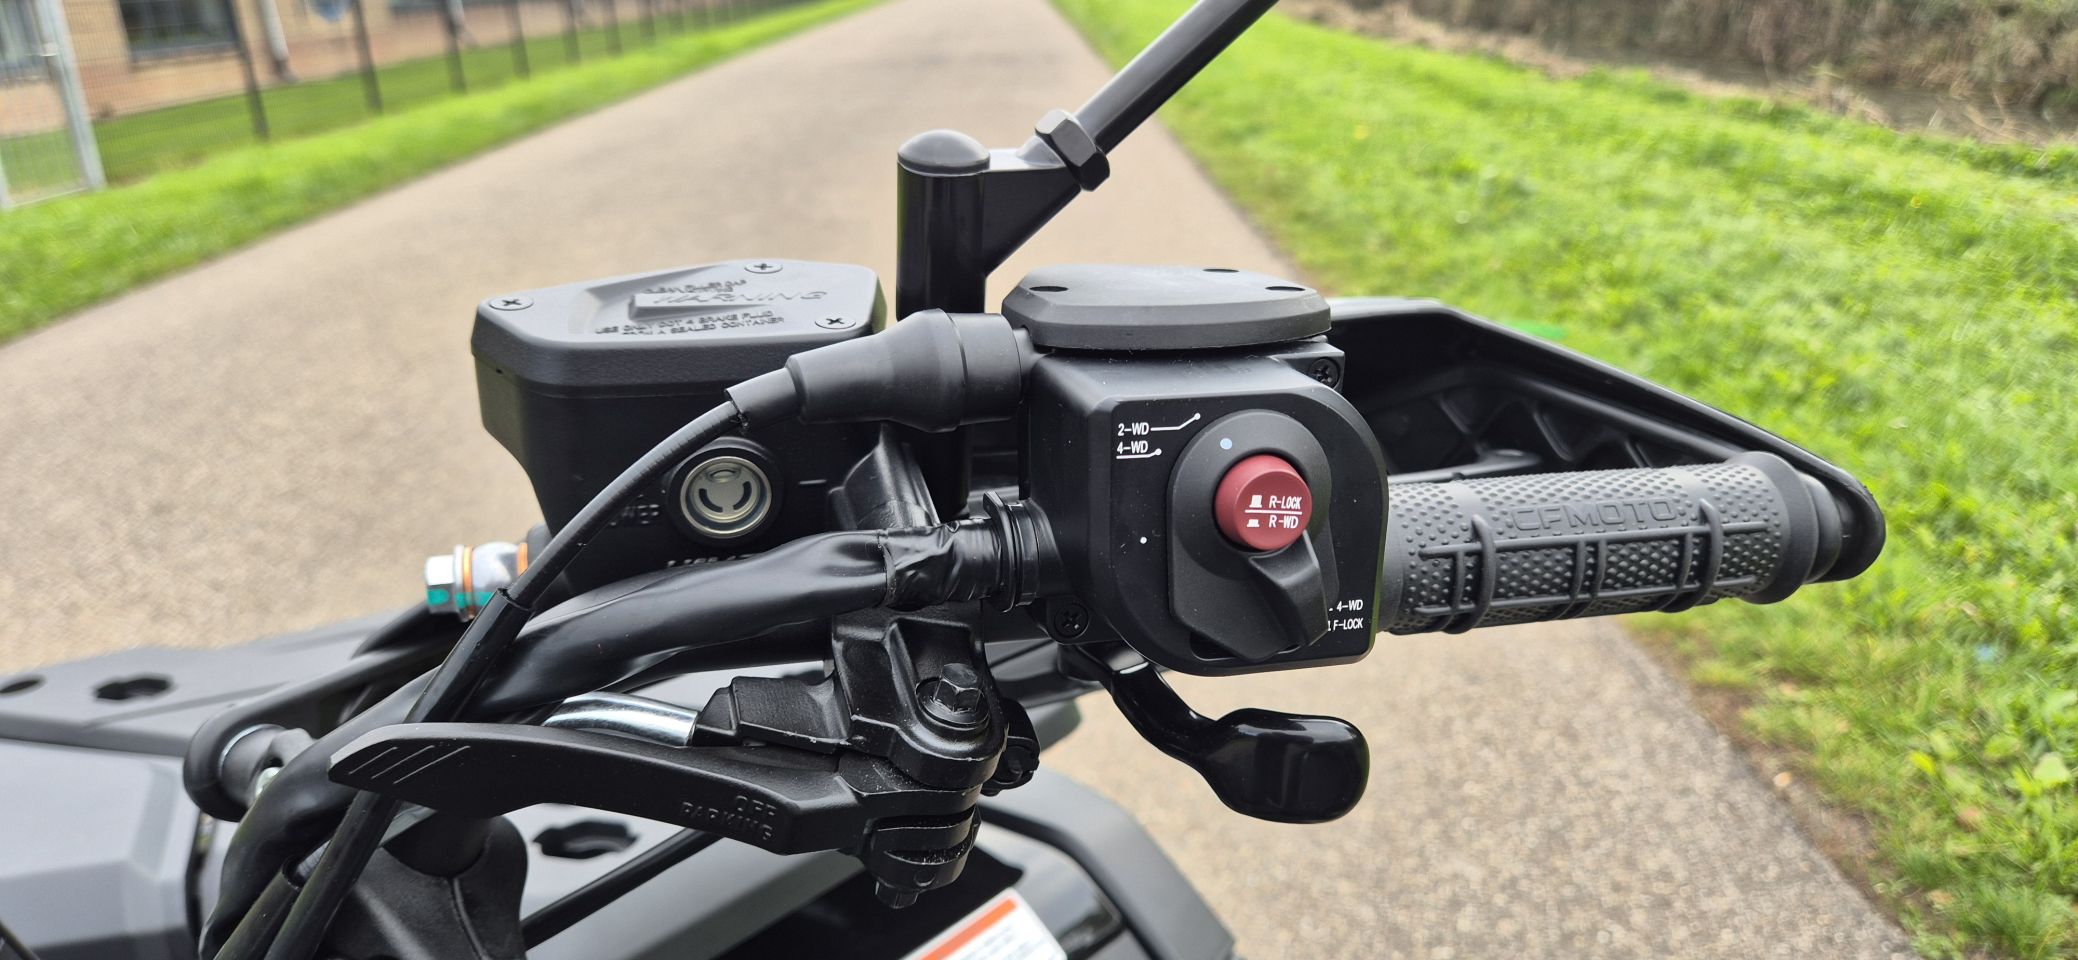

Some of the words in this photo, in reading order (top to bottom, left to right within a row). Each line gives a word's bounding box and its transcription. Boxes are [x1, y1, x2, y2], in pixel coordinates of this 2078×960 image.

[699, 314, 739, 325] BRAKE
[721, 317, 785, 329] CONTAINER
[1117, 422, 1150, 437] 2-WD
[1116, 440, 1149, 455] 4-WD
[1268, 495, 1302, 509] R-LOCK
[1268, 516, 1298, 529] R-WD
[1511, 500, 1677, 532] CFMOTO
[1336, 599, 1363, 612] 4-WD
[1333, 617, 1364, 631] F-LOCK
[735, 795, 777, 818] OFF
